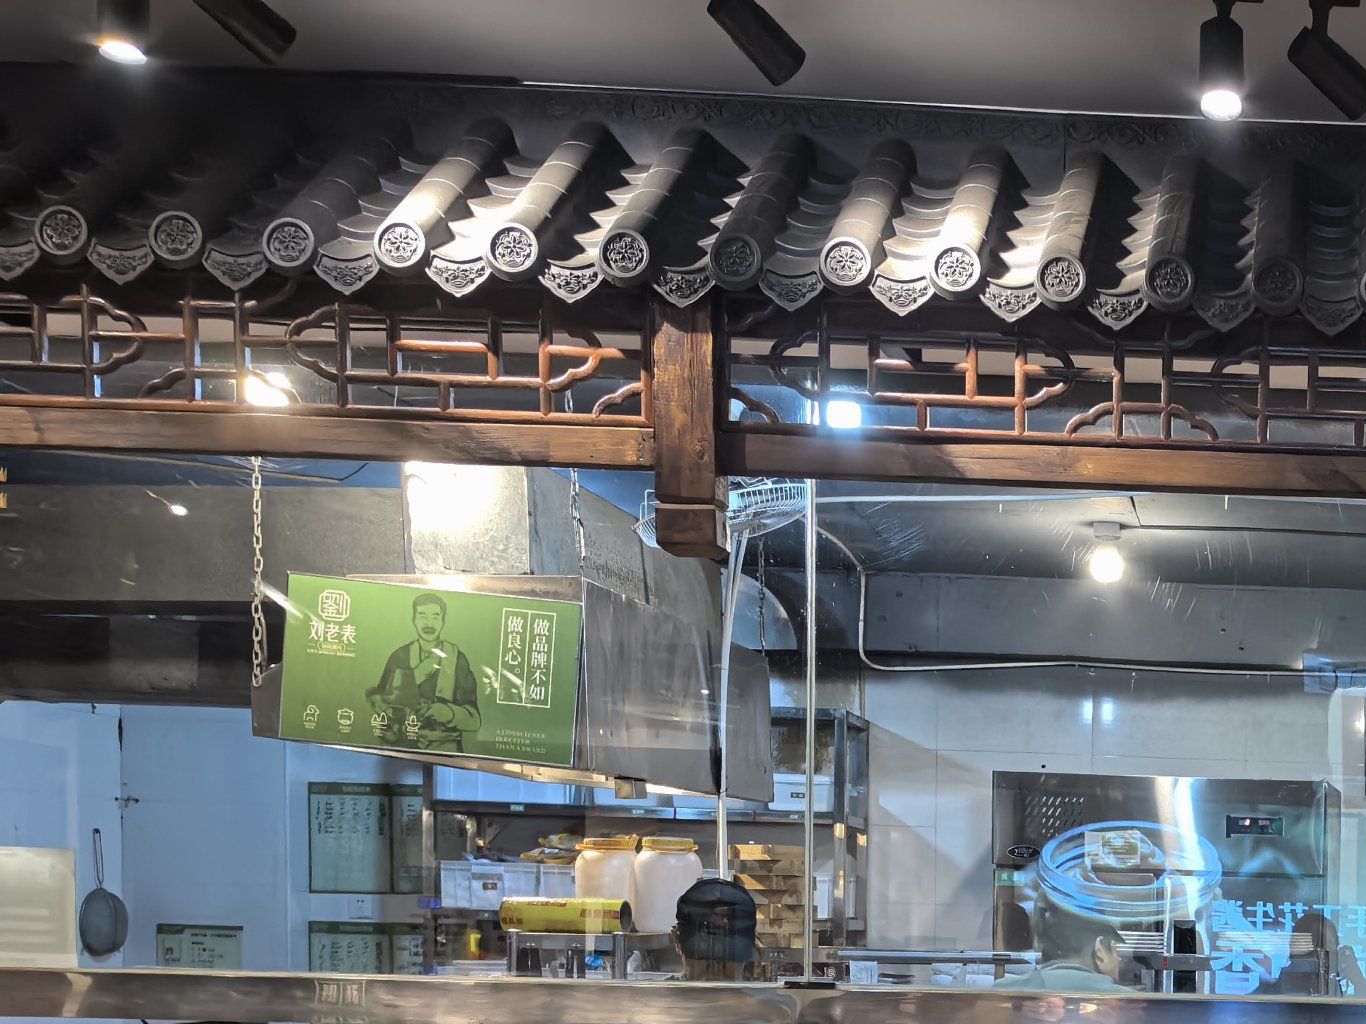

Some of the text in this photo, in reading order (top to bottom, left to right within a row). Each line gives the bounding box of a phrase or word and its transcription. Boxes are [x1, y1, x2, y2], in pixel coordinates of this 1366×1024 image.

[308, 620, 356, 644] 刘老表
[504, 615, 524, 674] 做良心。
[530, 618, 550, 700] 做品牌不如
